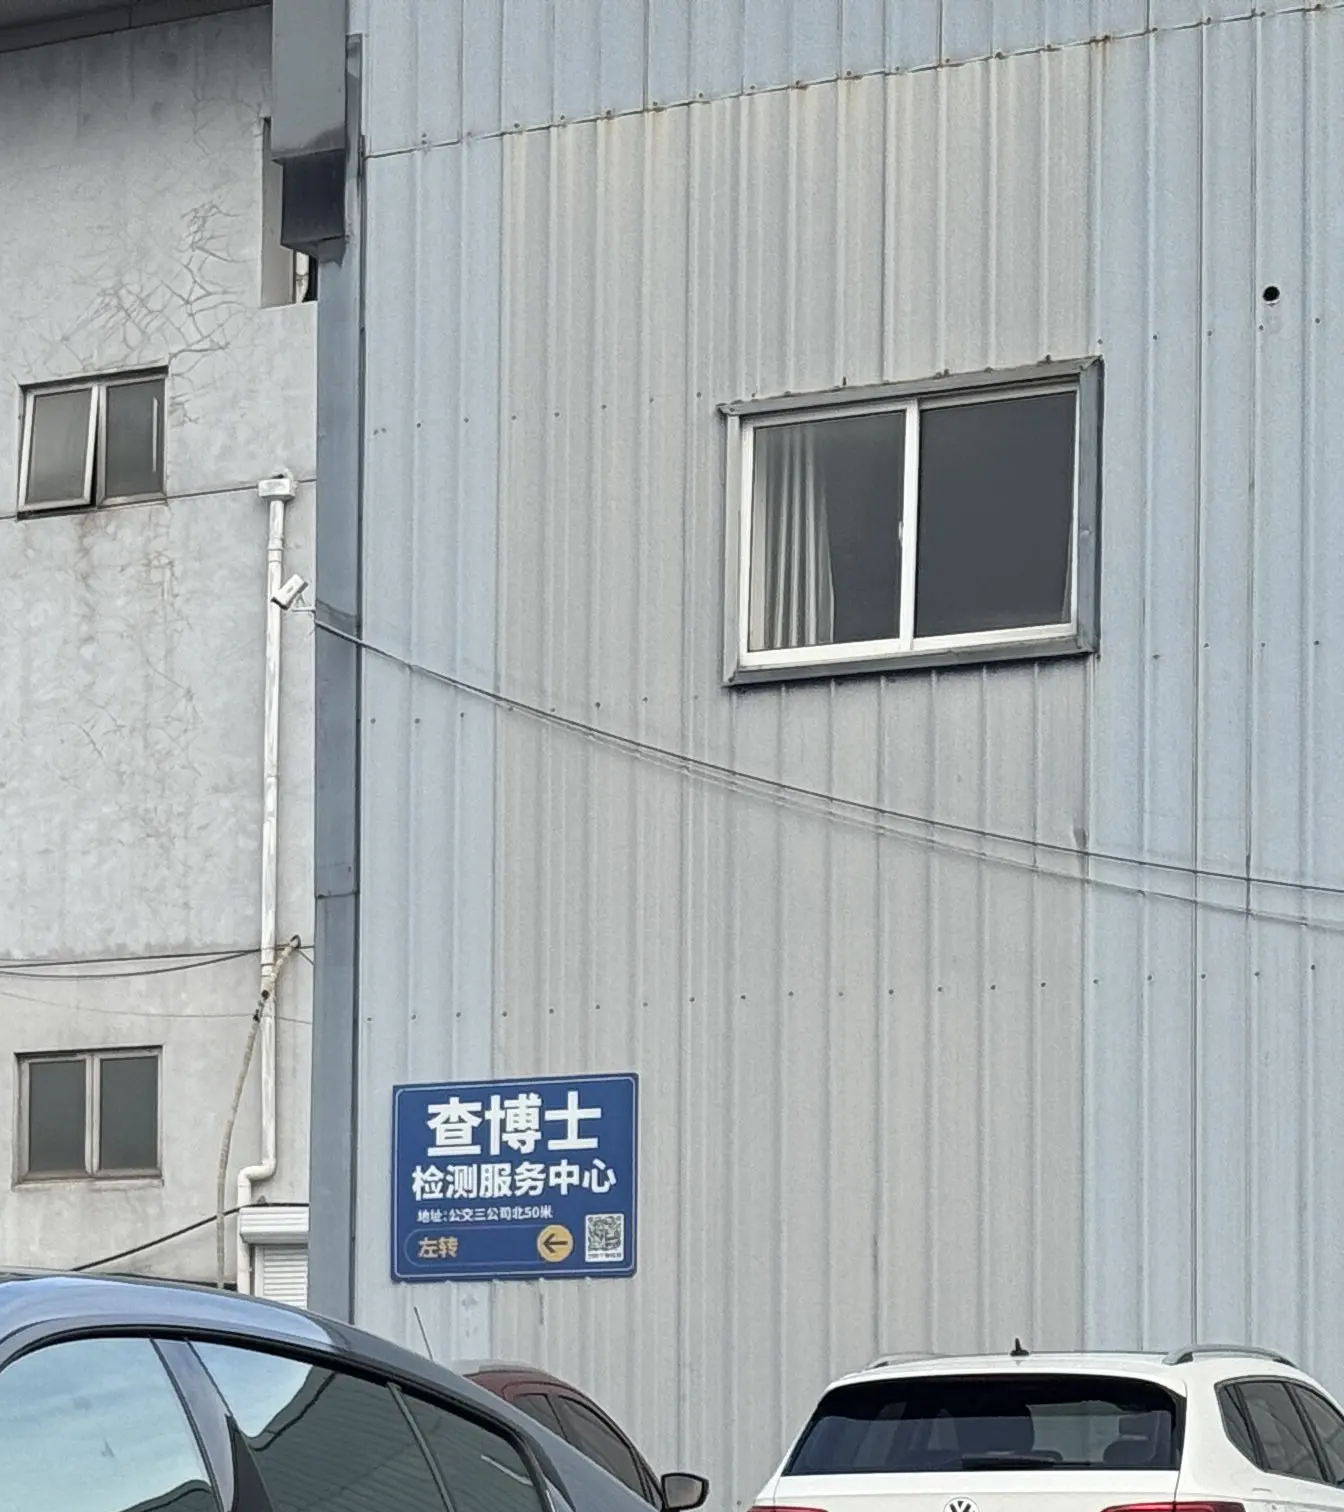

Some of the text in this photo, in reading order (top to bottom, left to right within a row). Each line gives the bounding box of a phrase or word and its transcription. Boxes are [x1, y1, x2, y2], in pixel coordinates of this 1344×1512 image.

[426, 1090, 602, 1157] 查博士
[412, 1158, 617, 1201] 检测服务中心
[418, 1236, 458, 1258] 左转
